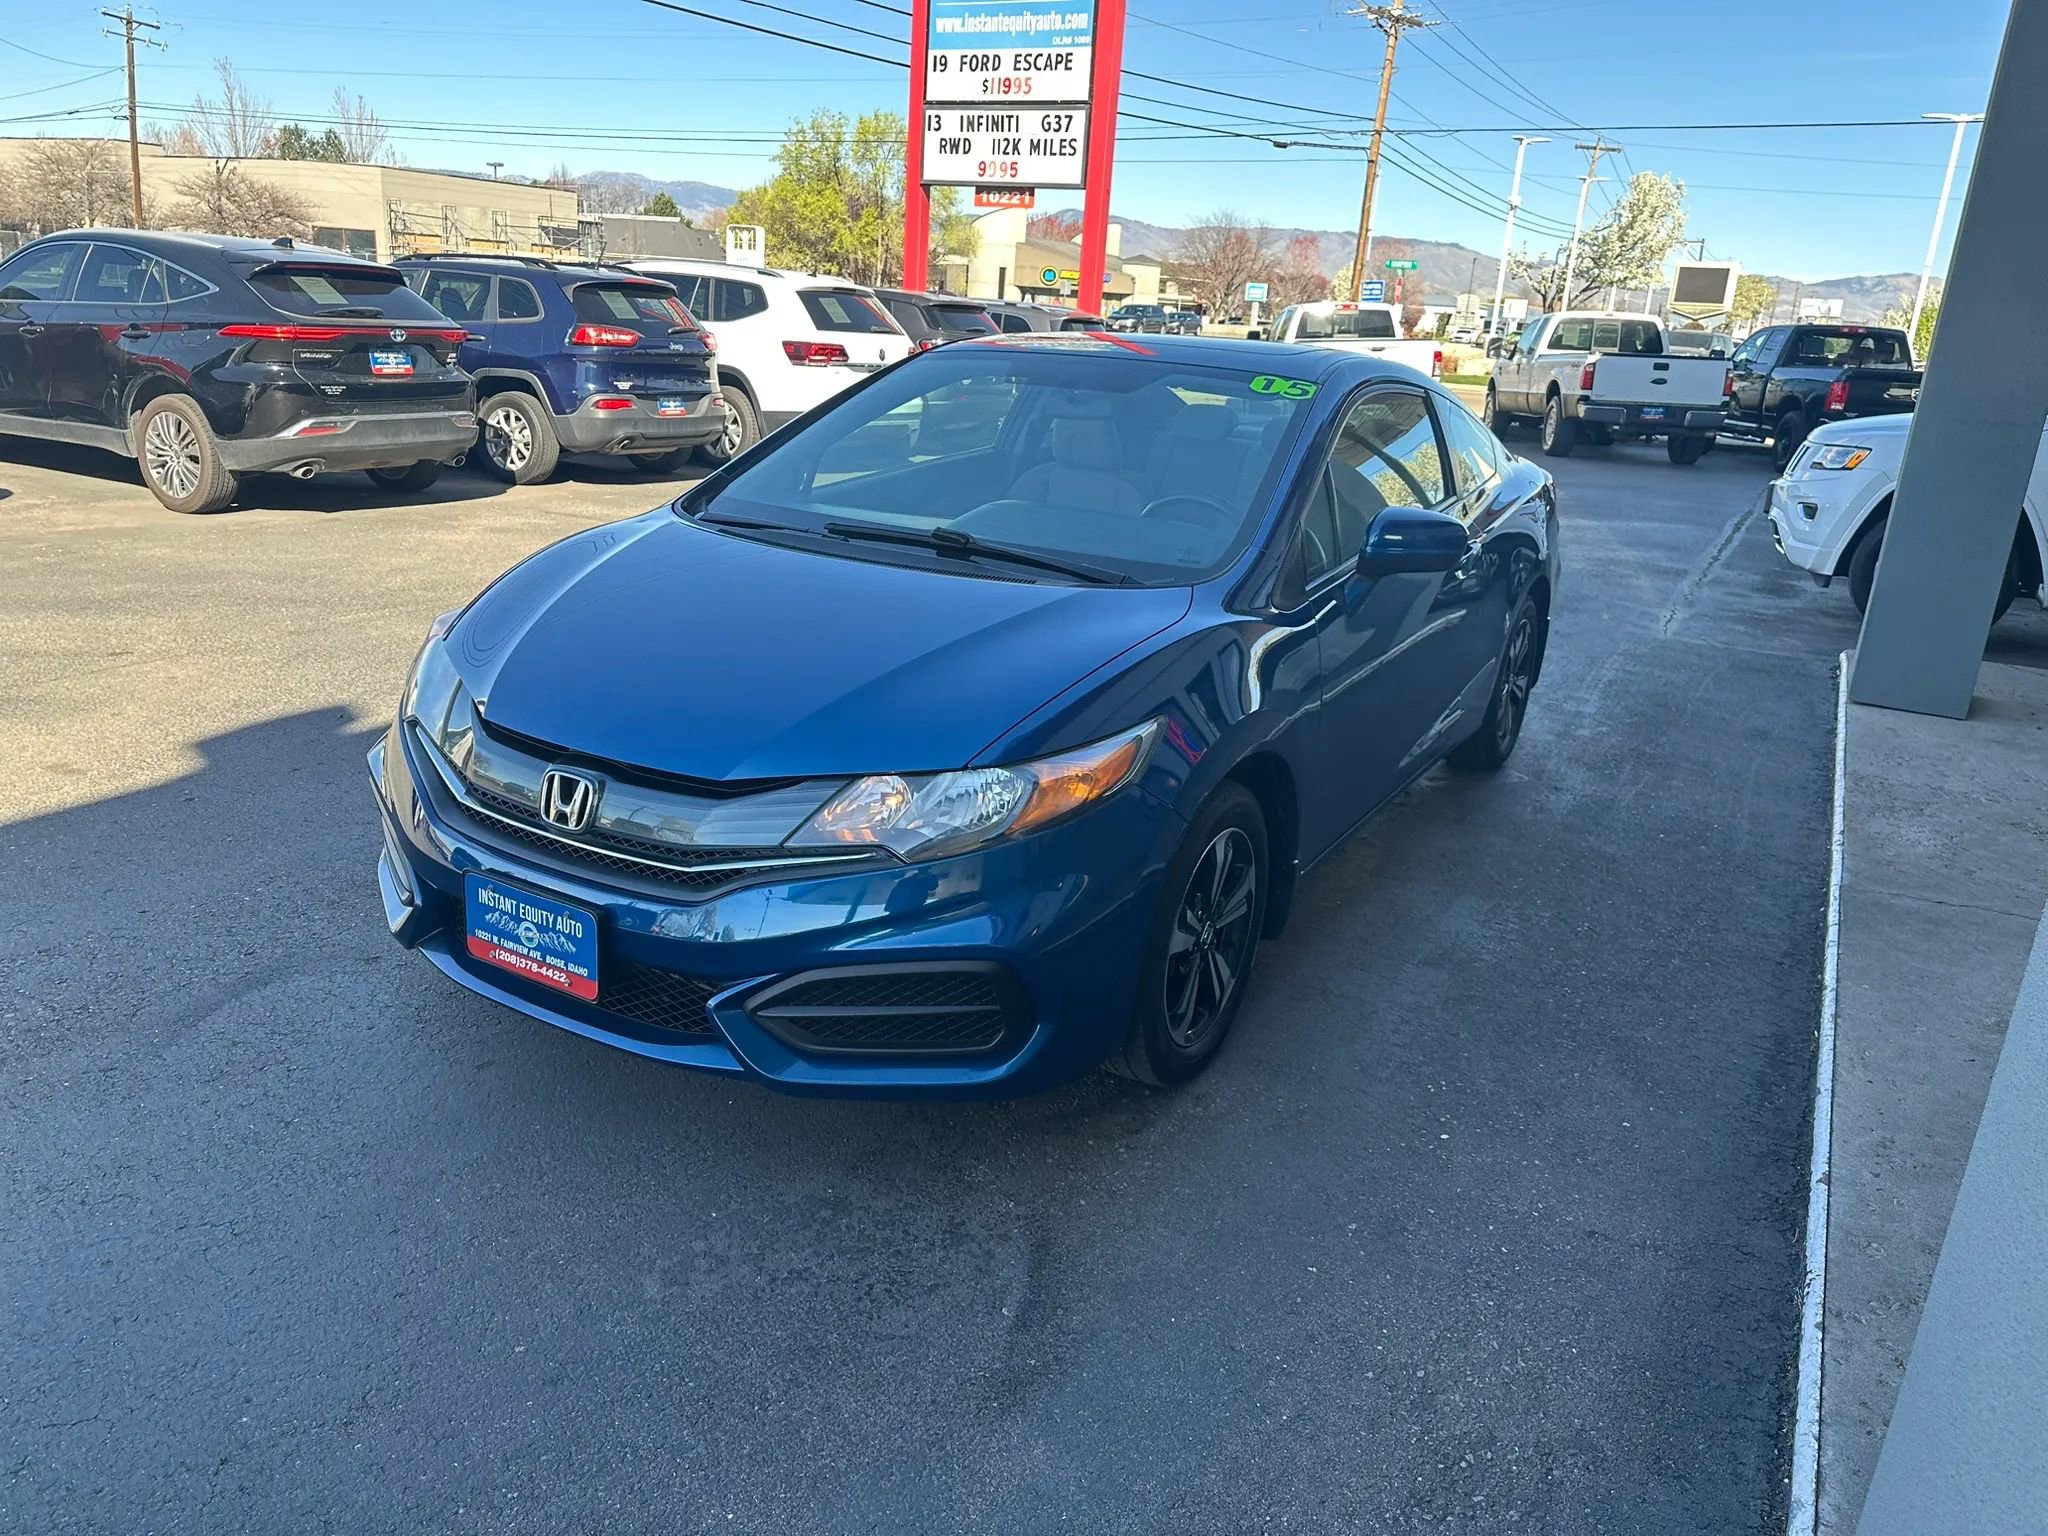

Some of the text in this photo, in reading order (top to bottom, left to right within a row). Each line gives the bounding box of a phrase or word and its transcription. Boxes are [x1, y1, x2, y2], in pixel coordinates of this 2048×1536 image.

[935, 11, 1088, 36] www.instantequityauto.com
[932, 52, 1073, 72] 19 FORD ESCAPE
[982, 77, 1032, 95] $11995
[927, 114, 1073, 133] 13 INFINITI G37
[939, 137, 1077, 157] RWD 112K MILES
[977, 160, 1018, 178] 9995
[979, 190, 1030, 205] 10221
[1257, 376, 1313, 398] 15
[478, 887, 583, 938] INSTANT EQUITY AUTO
[475, 928, 492, 941] 10221
[500, 938, 529, 956] FAIRVIEW
[529, 950, 543, 962] AVE.
[545, 955, 567, 972] BOISE,
[567, 962, 589, 977] IDAHO
[495, 948, 567, 983] (208)378-4422
